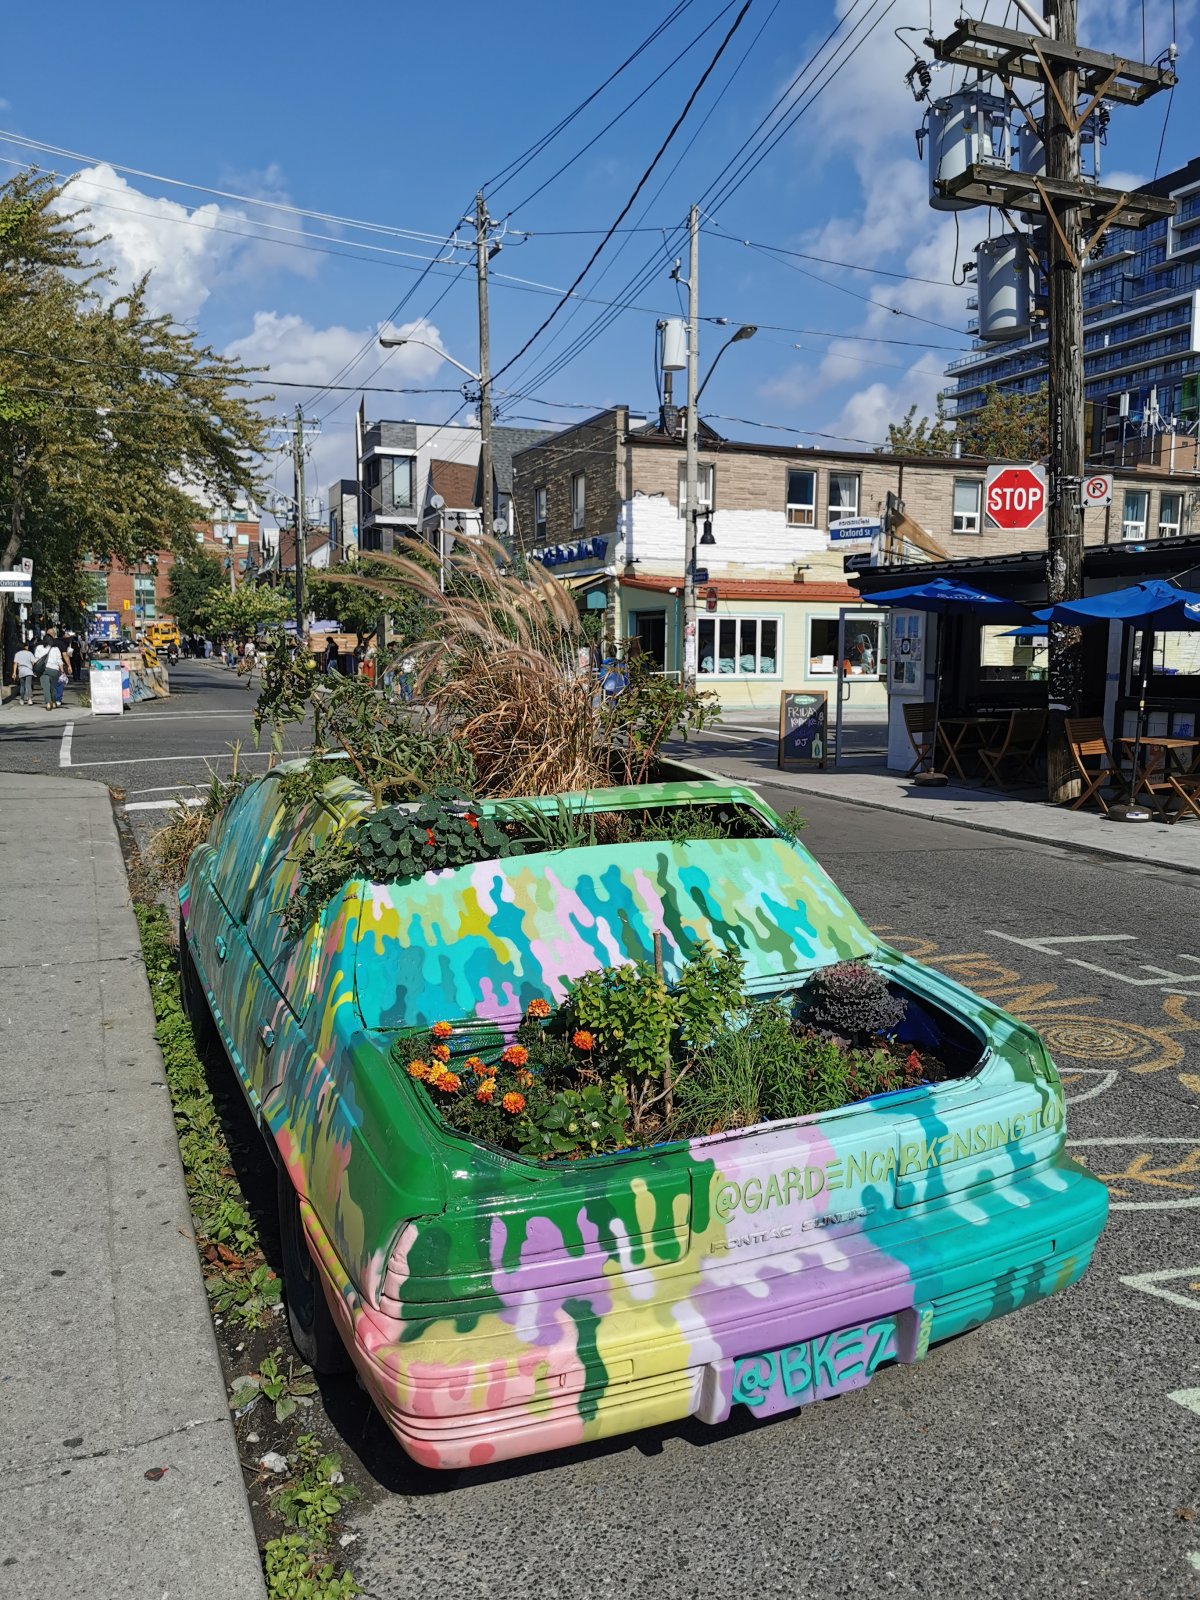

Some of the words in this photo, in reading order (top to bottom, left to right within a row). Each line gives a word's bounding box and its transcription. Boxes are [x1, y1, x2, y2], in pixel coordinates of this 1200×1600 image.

[990, 487, 1041, 511] STOP
[839, 528, 863, 538] Oxford
[788, 707, 817, 717] FRIDAY
[710, 1224, 793, 1253] PONTIAC
[732, 1321, 897, 1407] @BKEZ
